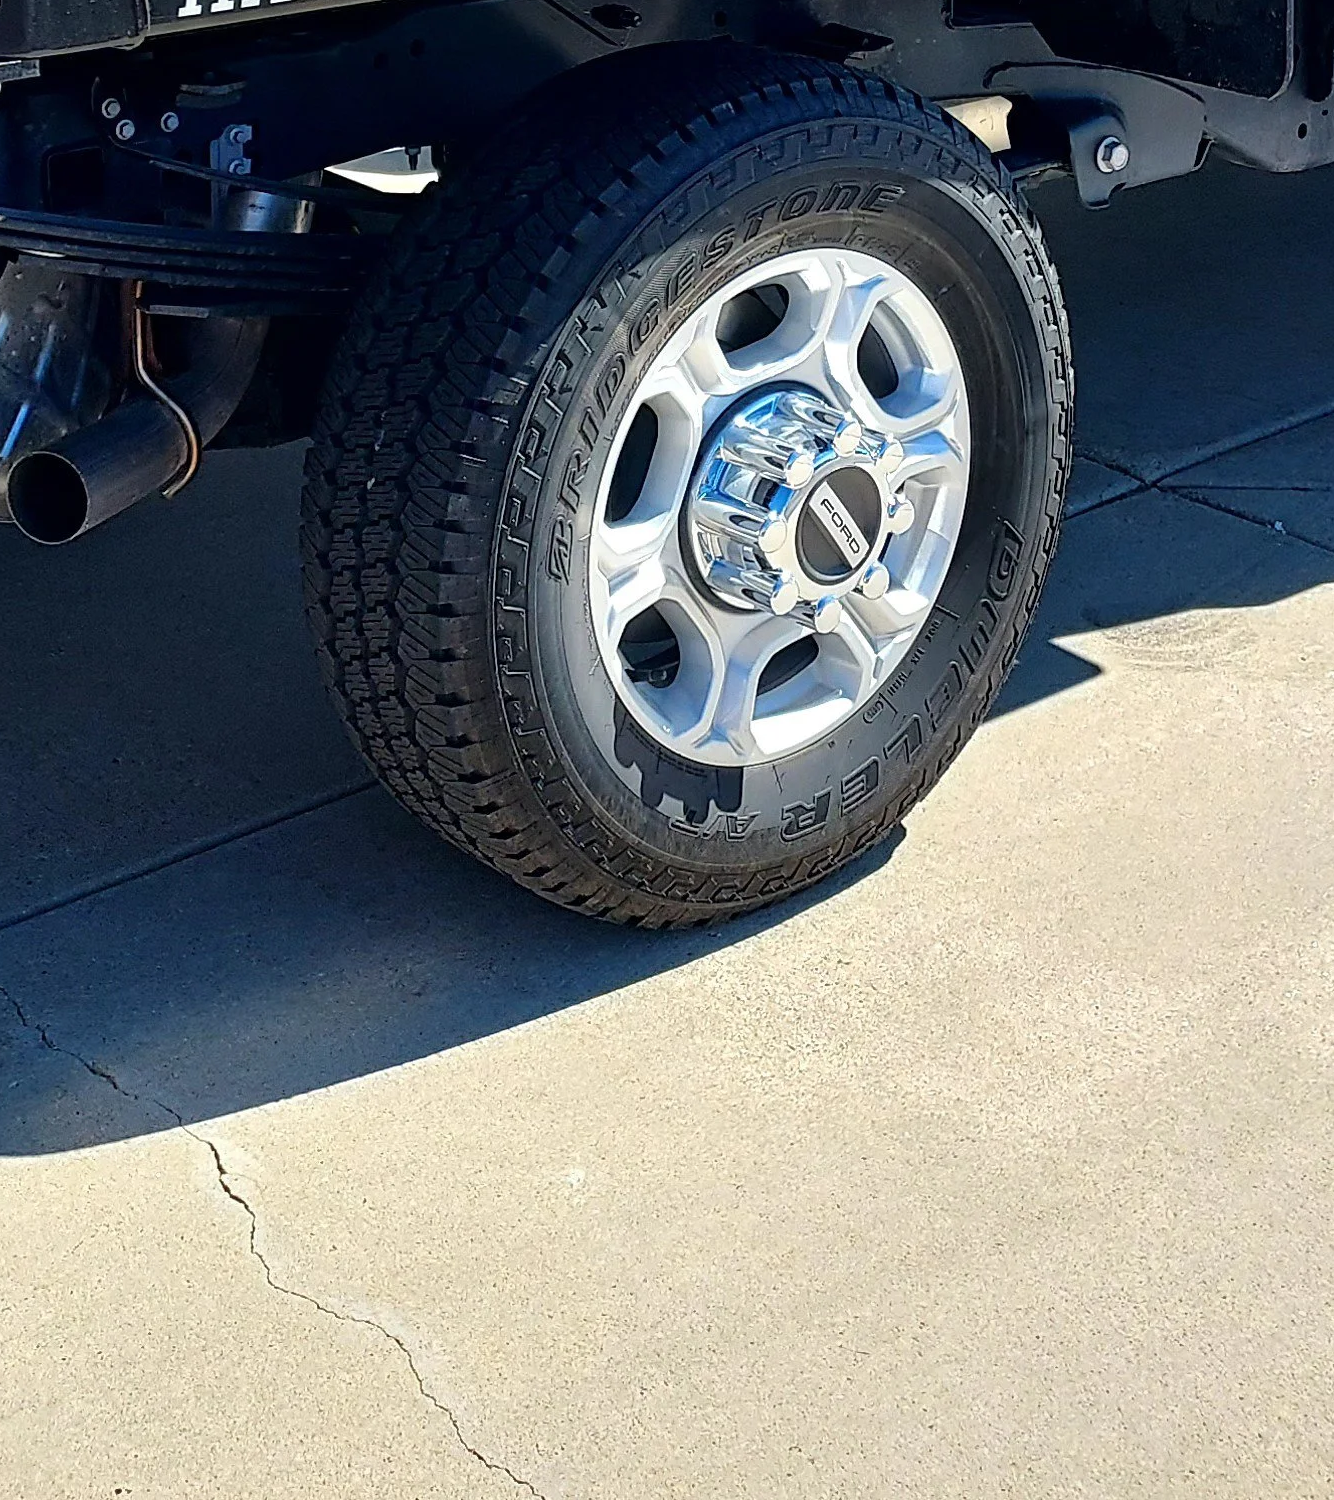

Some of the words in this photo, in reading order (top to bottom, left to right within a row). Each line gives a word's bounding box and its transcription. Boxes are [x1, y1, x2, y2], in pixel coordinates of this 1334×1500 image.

[819, 498, 861, 555] FORD
[779, 517, 1028, 844] DUELER
[668, 807, 761, 842] A/T
